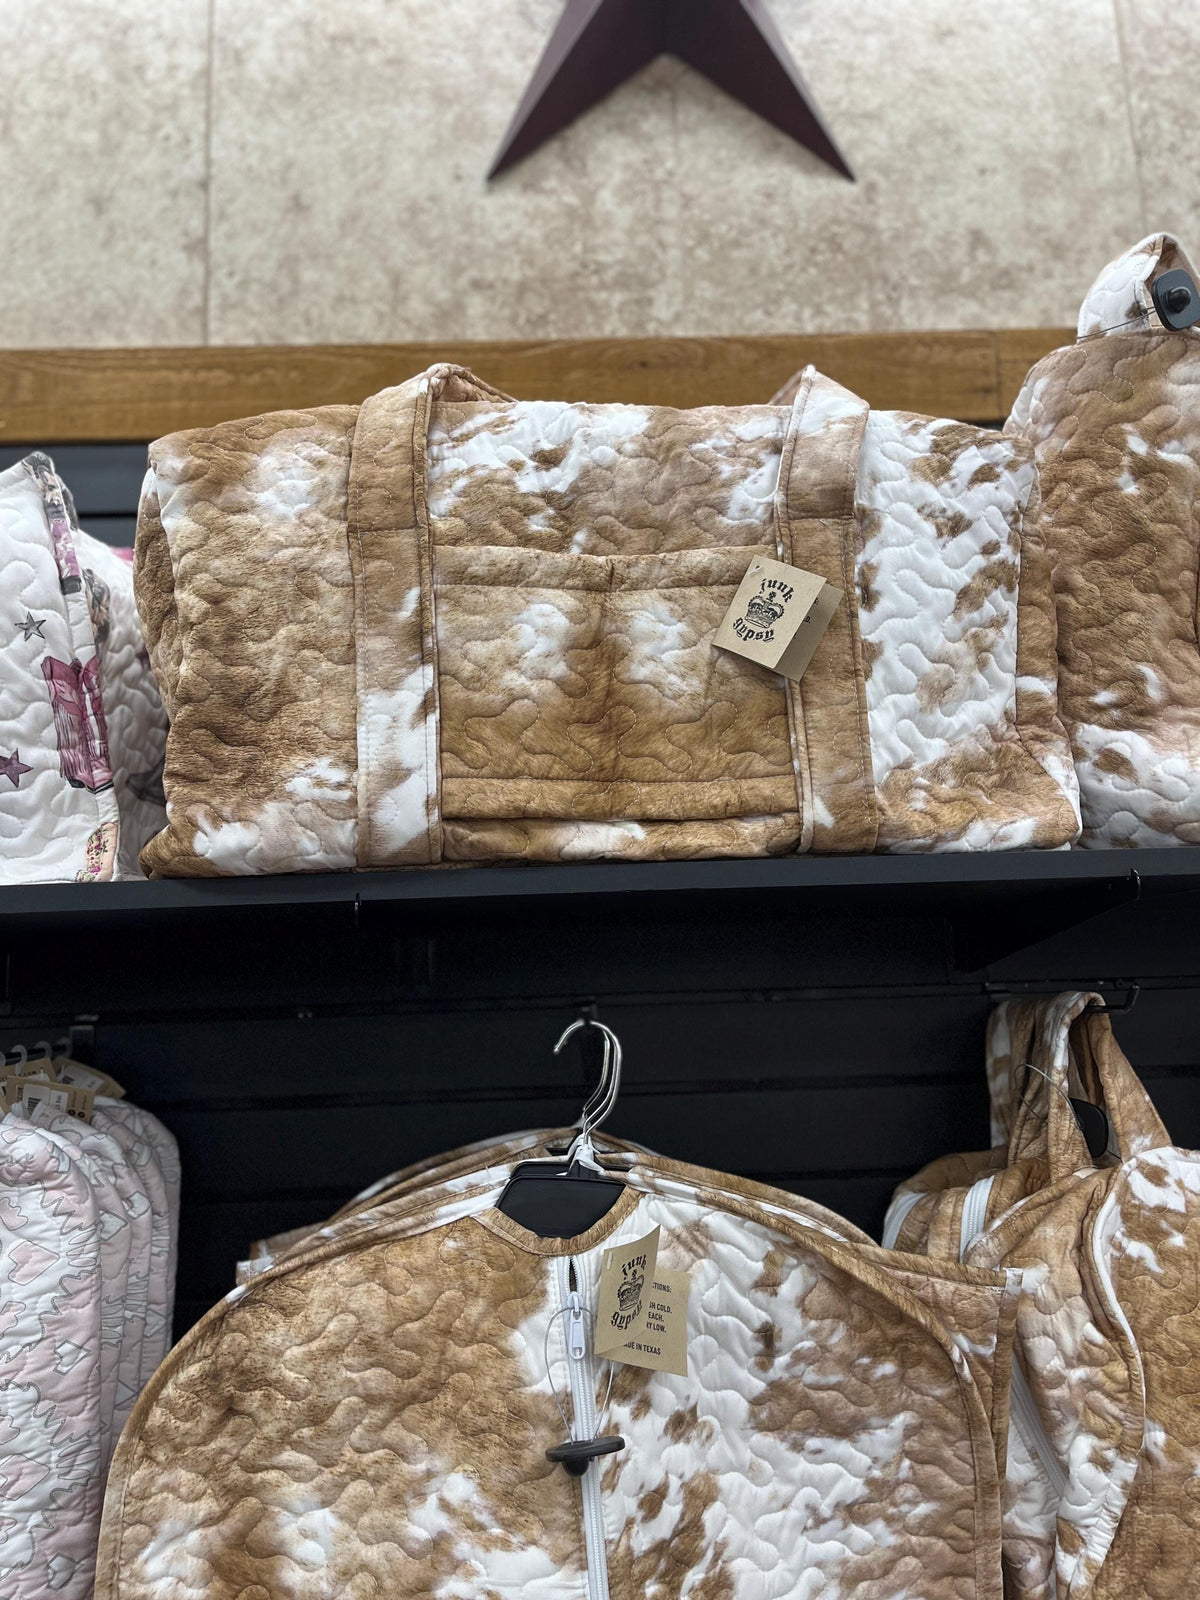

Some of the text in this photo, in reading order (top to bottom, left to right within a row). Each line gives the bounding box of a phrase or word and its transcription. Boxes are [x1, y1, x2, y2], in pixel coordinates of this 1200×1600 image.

[652, 1282, 672, 1293] TIONS:
[656, 1303, 672, 1314] COLD.
[653, 1323, 667, 1333] LOW.
[635, 1343, 642, 1351] IN
[643, 1344, 661, 1355] TEXAS
